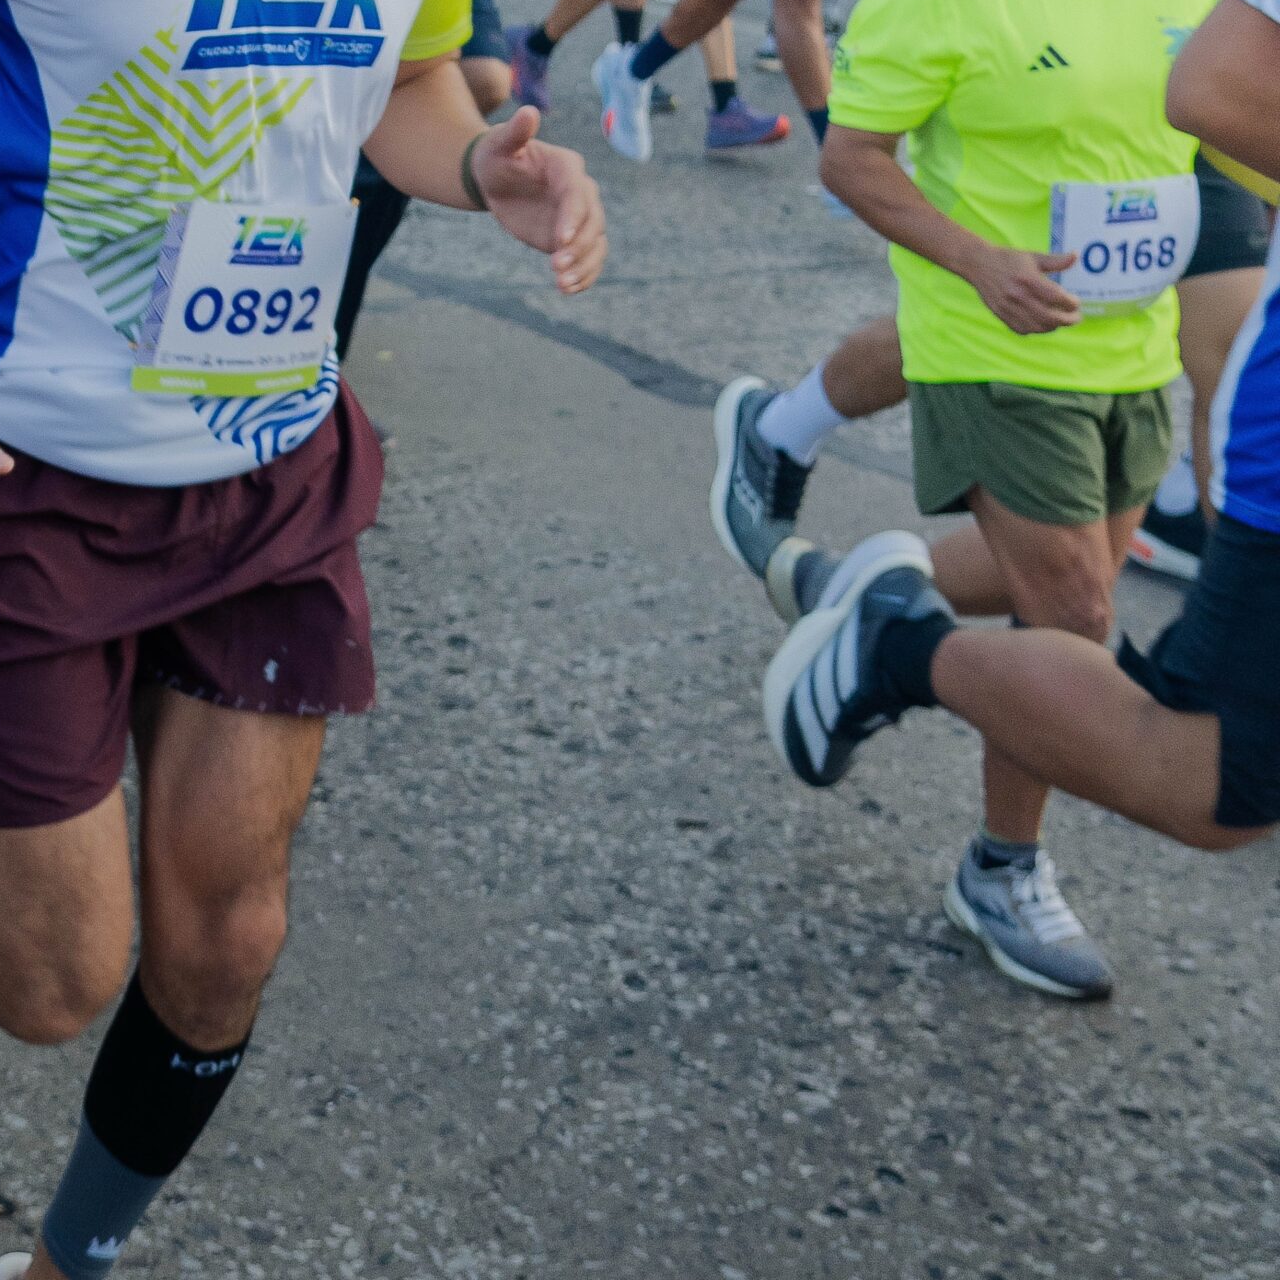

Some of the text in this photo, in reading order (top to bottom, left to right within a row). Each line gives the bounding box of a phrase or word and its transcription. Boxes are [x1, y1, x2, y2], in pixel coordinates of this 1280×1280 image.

[232, 215, 310, 252] 12k
[1082, 235, 1177, 274] 0168
[184, 286, 322, 336] 0892
